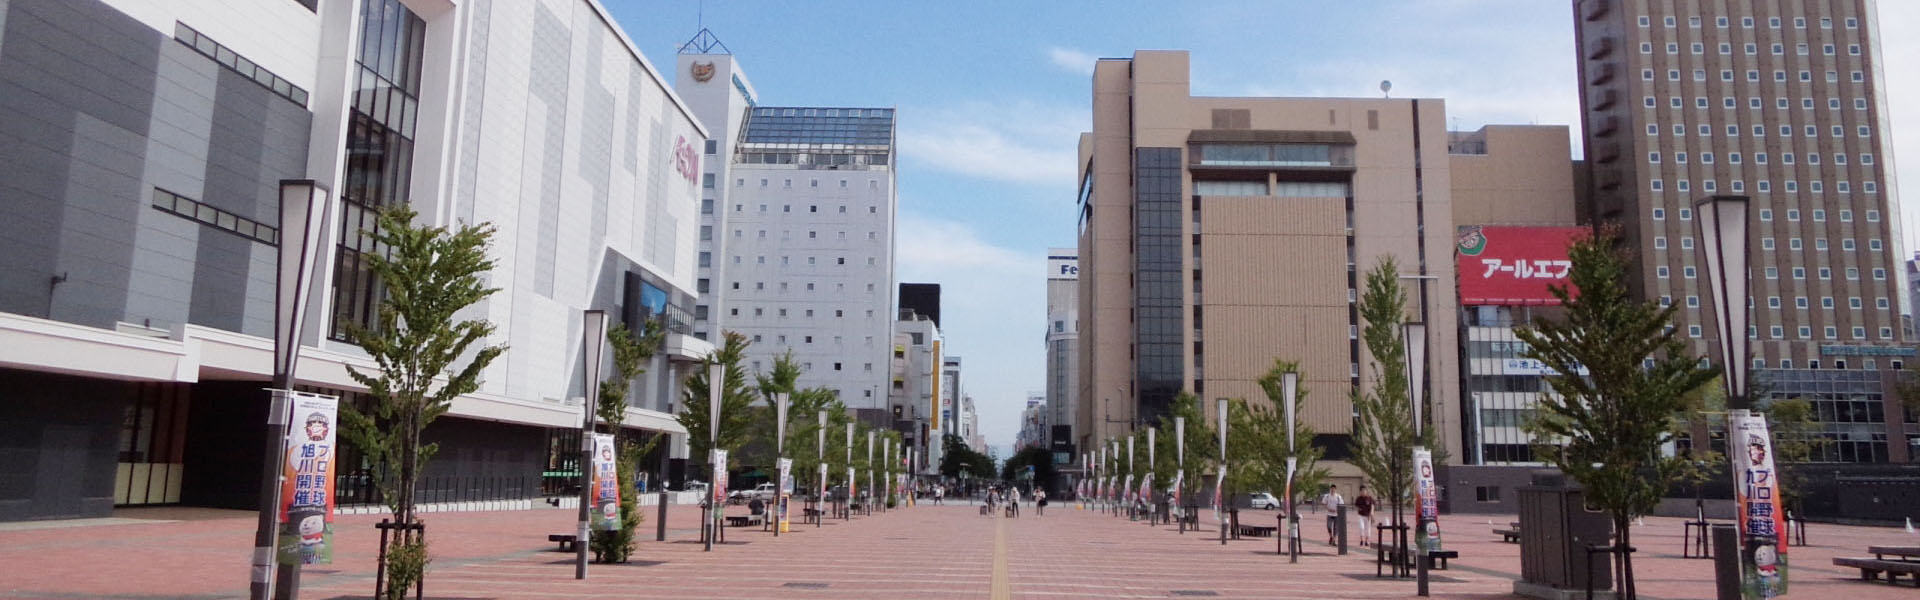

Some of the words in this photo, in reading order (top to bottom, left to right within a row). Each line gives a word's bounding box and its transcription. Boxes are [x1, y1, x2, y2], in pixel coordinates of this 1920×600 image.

[1481, 258, 1572, 279] アールエフ
[294, 443, 315, 506] 旭川開催
[312, 444, 330, 505] プロ野球
[1756, 468, 1774, 534] プロ野球
